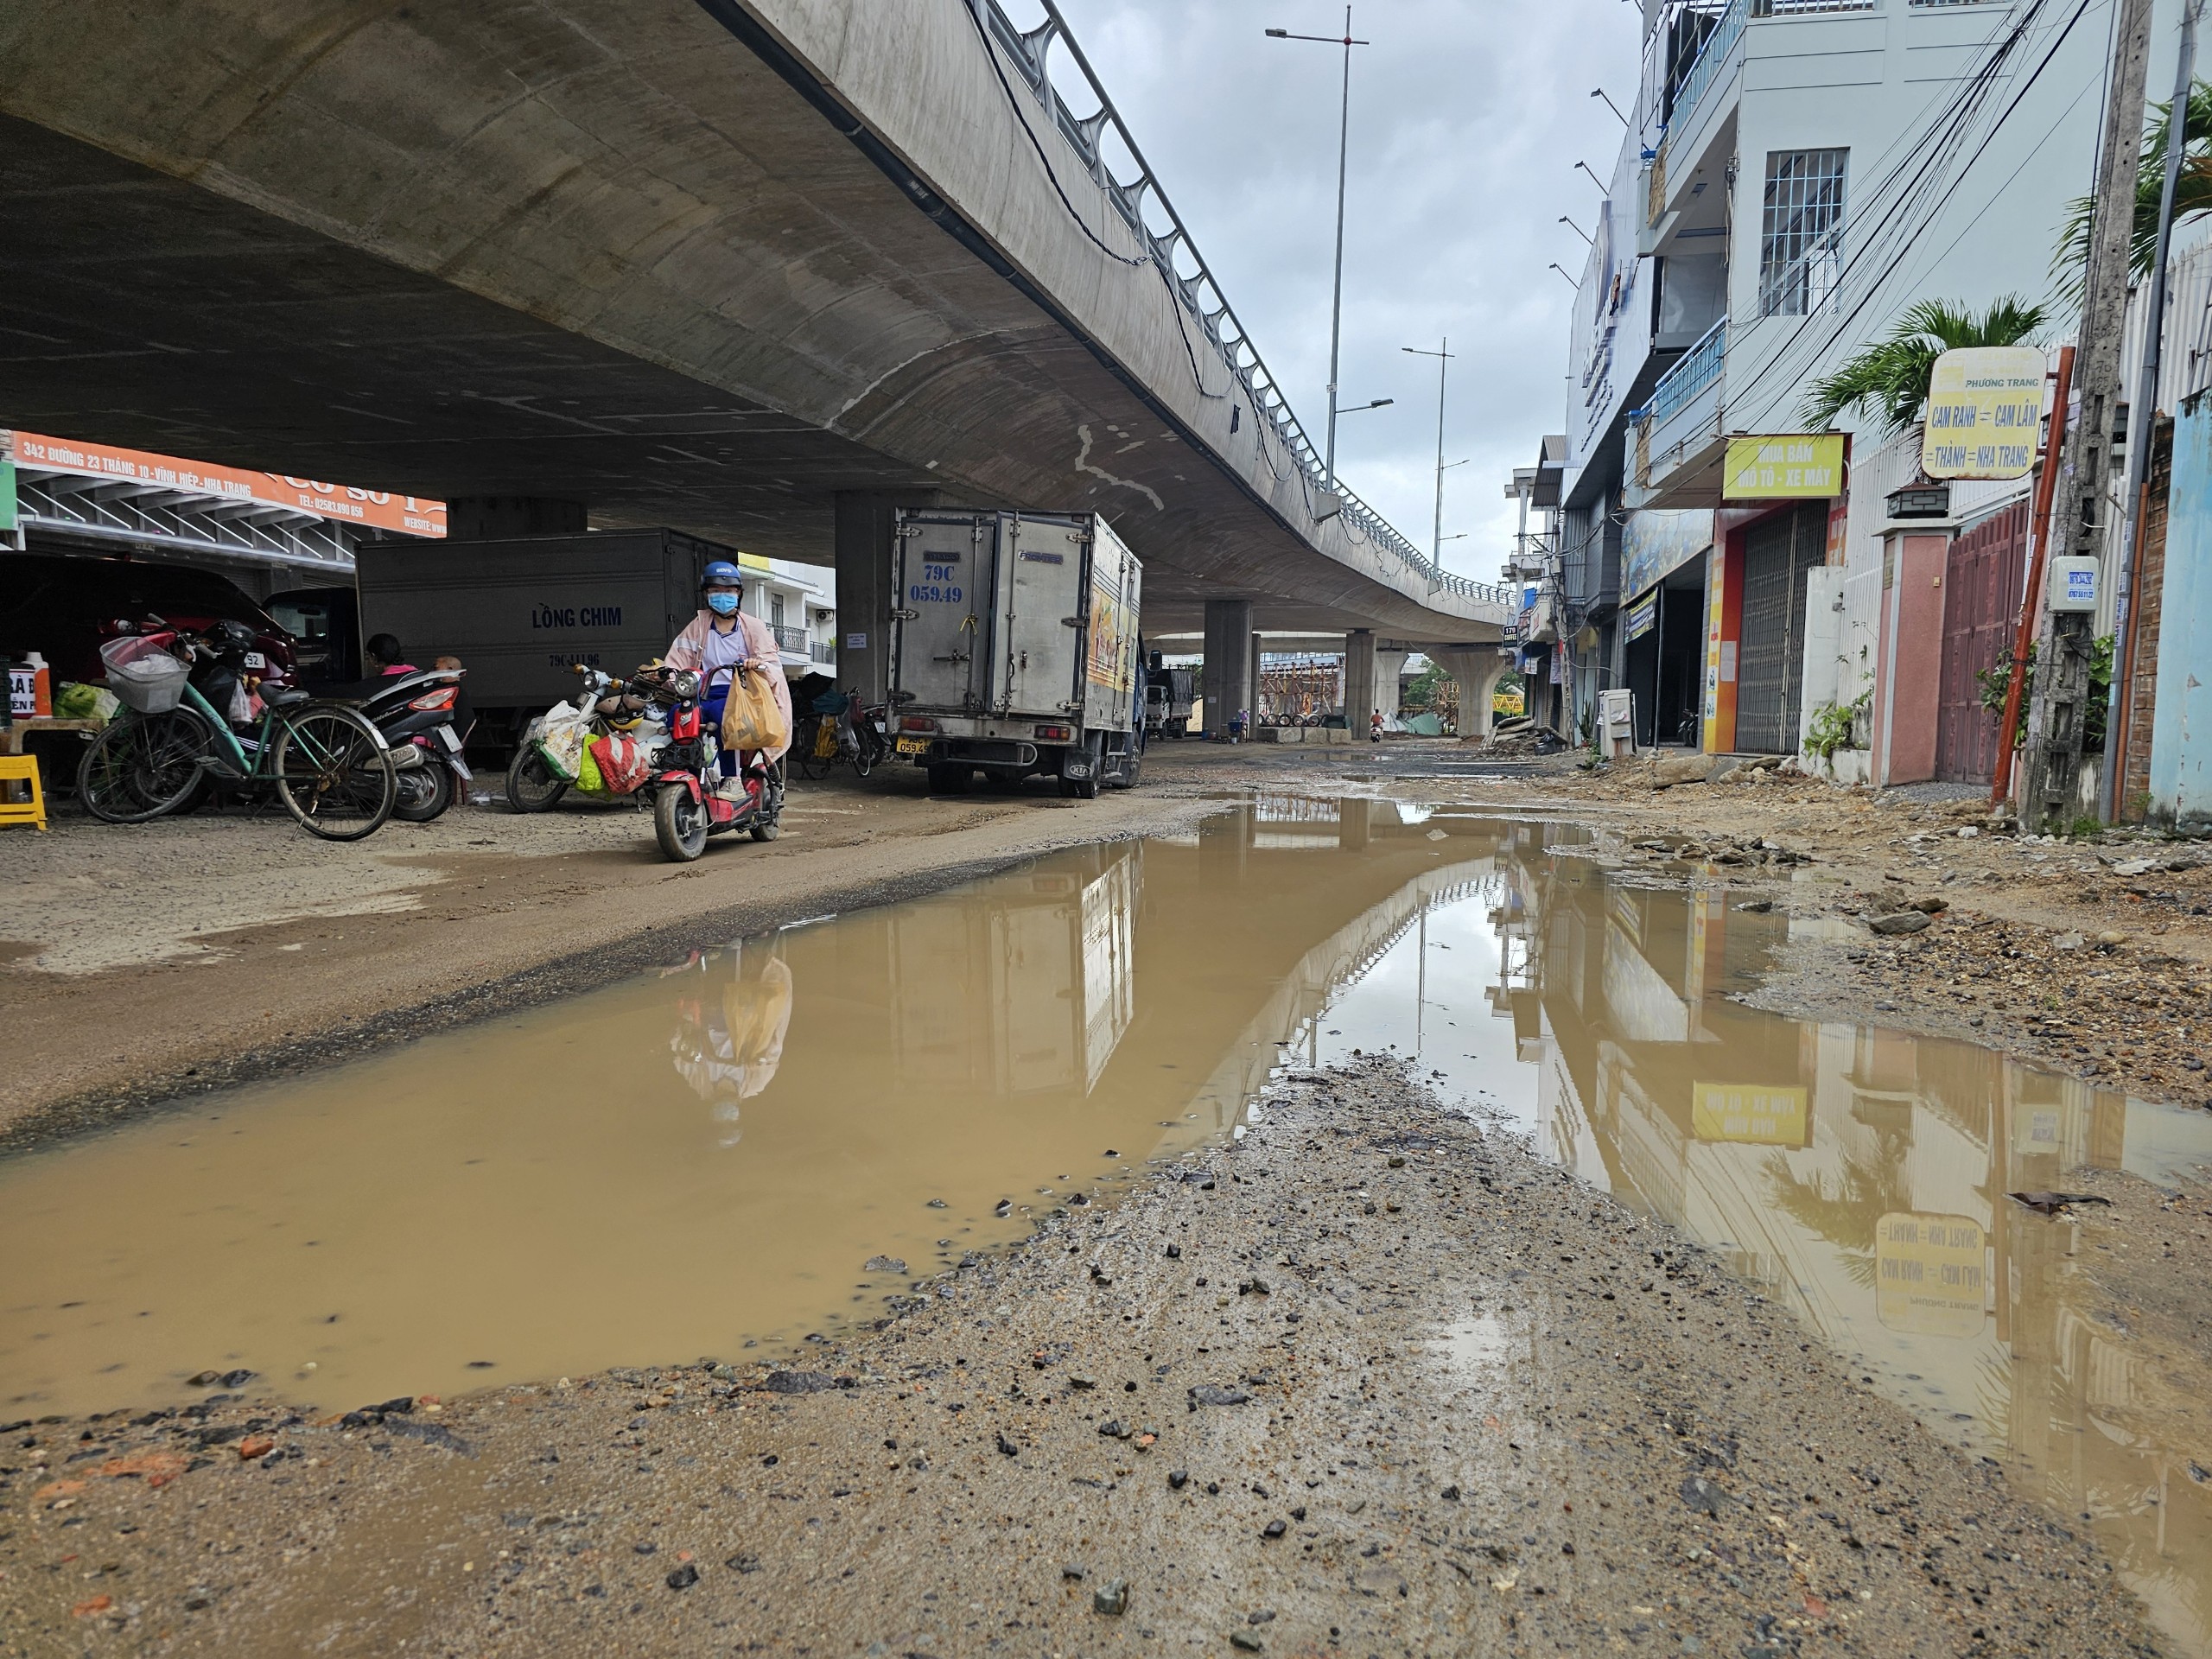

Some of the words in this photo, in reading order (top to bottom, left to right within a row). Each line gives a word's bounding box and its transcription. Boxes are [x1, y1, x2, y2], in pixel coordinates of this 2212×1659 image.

[1966, 378, 2005, 388] PHƯƠNG
[2007, 378, 2038, 387] TRANG
[1932, 405, 1951, 428] CAM
[1953, 405, 1976, 428] RANH
[1994, 404, 2016, 428] CAM
[2017, 398, 2037, 427] LÂM
[1758, 444, 1784, 463] MUA
[1787, 442, 1813, 463] BÁN
[1935, 440, 1967, 467] THÀNH
[1976, 446, 1995, 467] NHA
[1999, 445, 2029, 467] TRANG
[23, 442, 45, 459] 342
[48, 446, 84, 467] ĐƯỜNG
[87, 454, 100, 469] 23
[103, 456, 135, 476] THÁNG
[224, 480, 251, 496] TRANG
[1738, 467, 1758, 488] MÔ
[1760, 466, 1775, 487] TÔ
[1785, 468, 1802, 487] XE
[1804, 465, 1831, 487] MÁY
[299, 494, 314, 508] TEL:
[350, 505, 363, 518] 856
[404, 516, 431, 531] WEBSITE:
[924, 564, 955, 582] 79C
[910, 585, 963, 603] 059.49
[532, 602, 575, 629] LỒNG
[580, 607, 622, 626] CHIM
